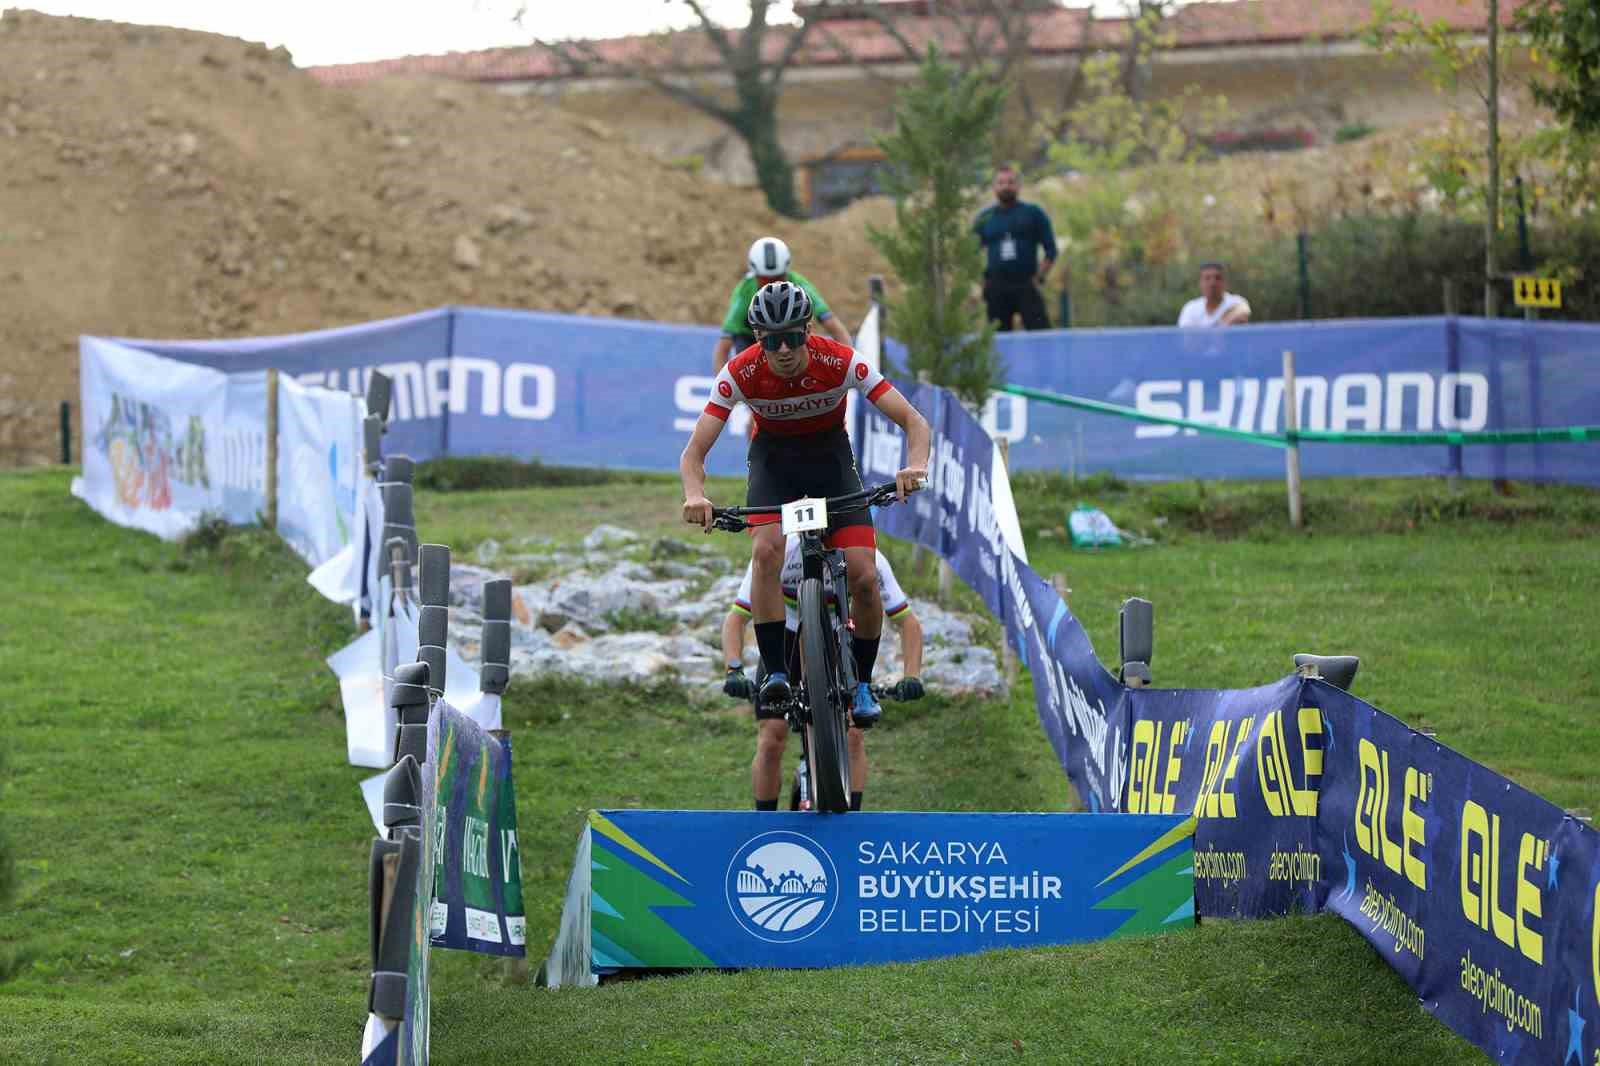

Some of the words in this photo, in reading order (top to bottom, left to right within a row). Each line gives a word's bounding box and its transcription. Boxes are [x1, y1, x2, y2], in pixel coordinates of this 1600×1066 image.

[1136, 373, 1488, 439] SHIMANO
[795, 507, 814, 522] 11
[857, 841, 1008, 865] SAKARYA
[858, 870, 1063, 903] BÜYÜKŞEHİR
[859, 905, 1040, 933] BELEDİYESİ
[1359, 875, 1425, 961] alecycling.com
[1460, 948, 1543, 1041] alecycling.com
